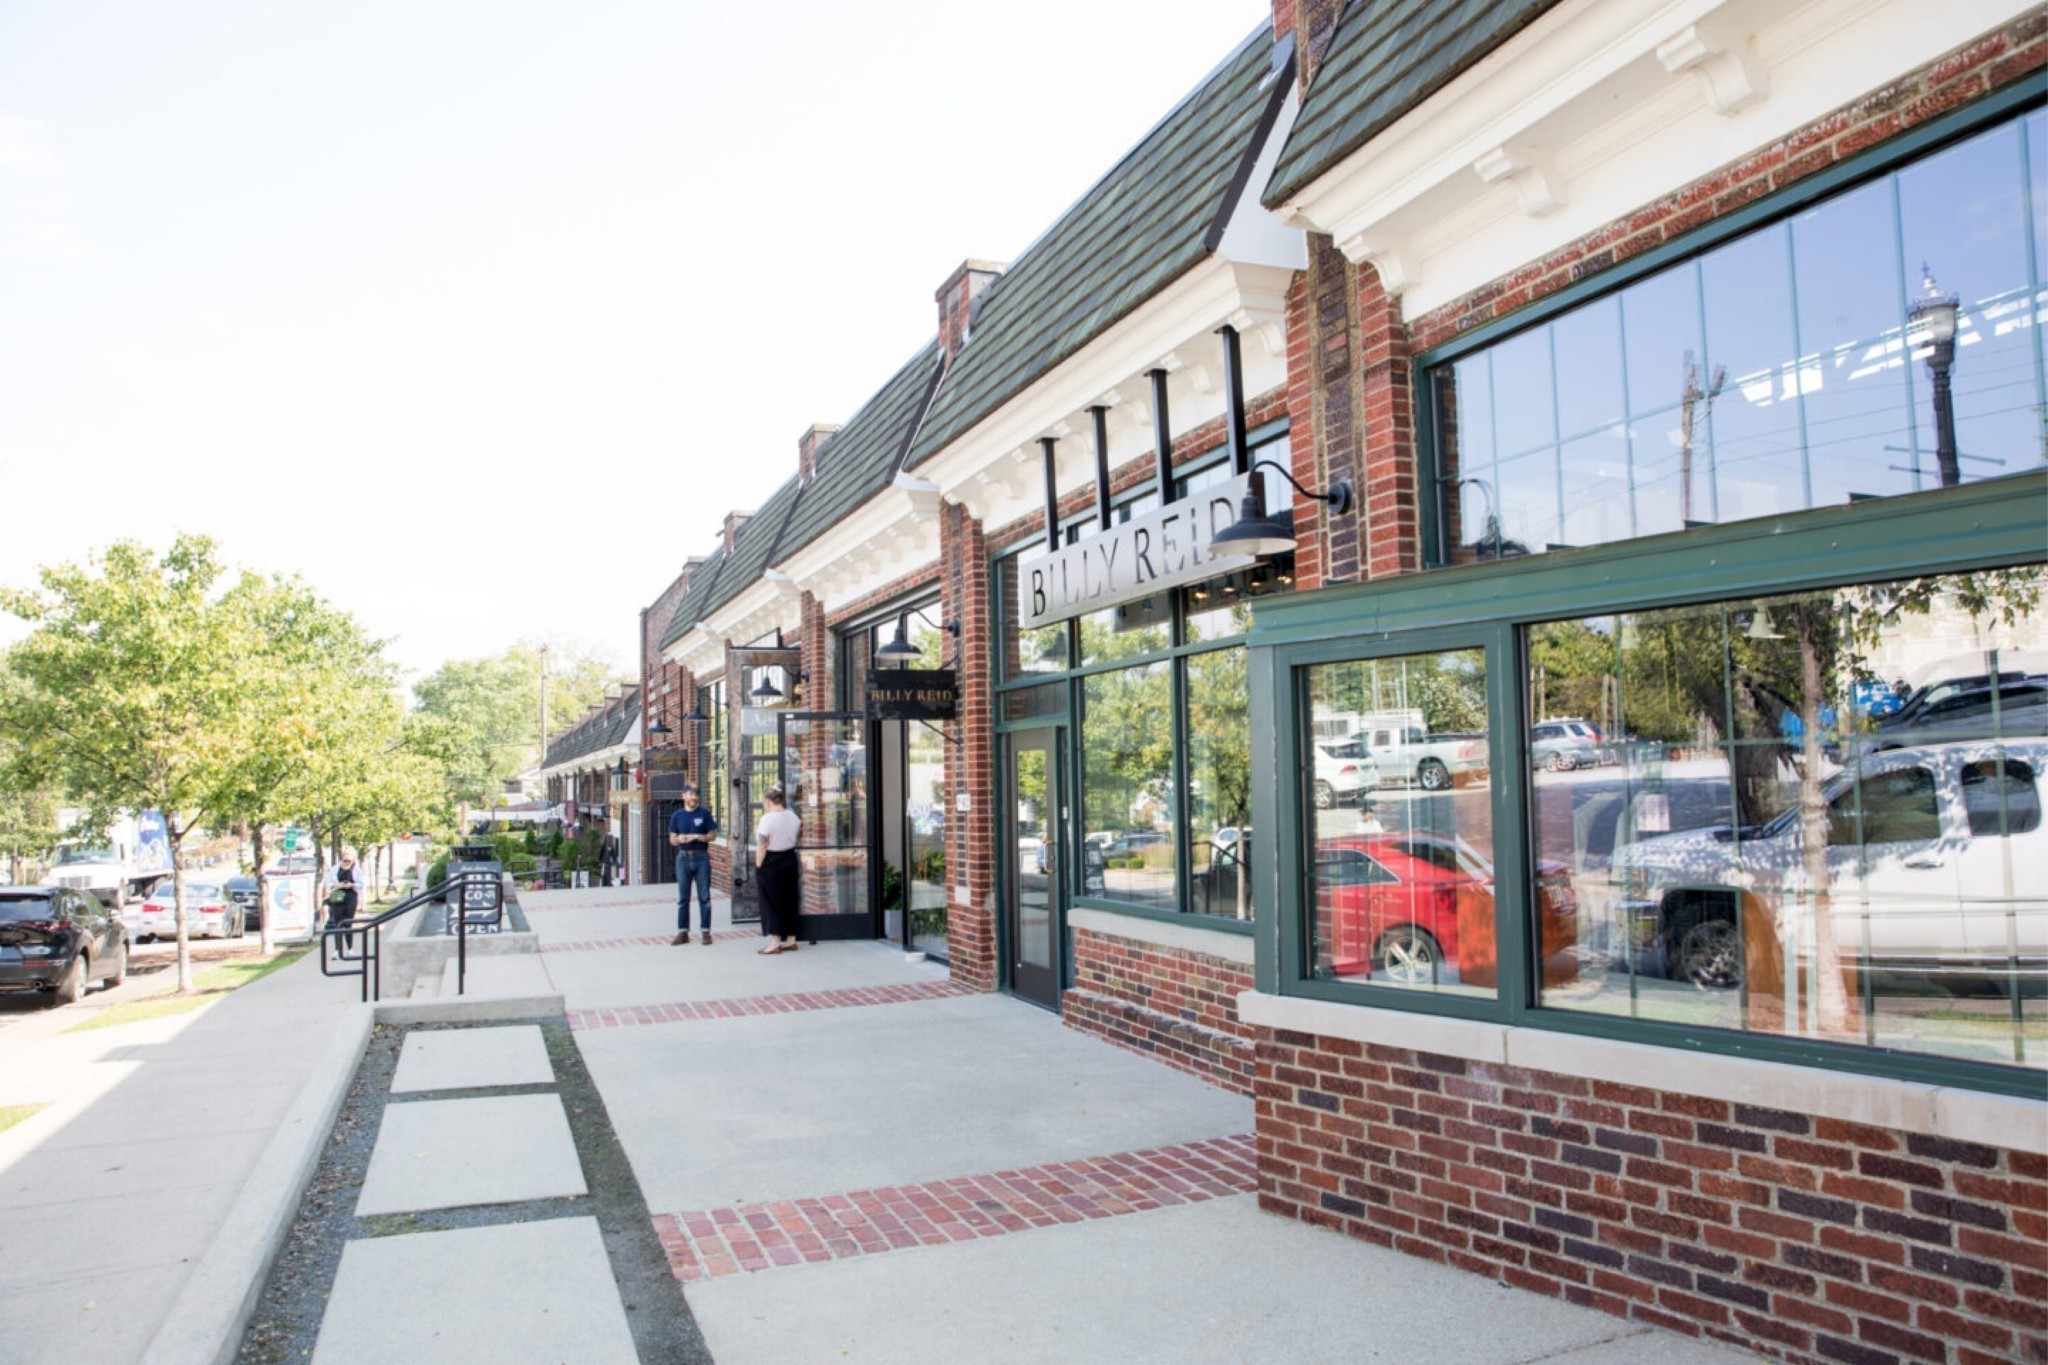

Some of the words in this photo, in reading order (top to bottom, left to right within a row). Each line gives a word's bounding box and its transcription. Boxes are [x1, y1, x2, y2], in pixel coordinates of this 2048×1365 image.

[1031, 537, 1119, 618] BILLY
[1134, 497, 1236, 584] REID
[871, 688, 913, 702] BILLY
[916, 689, 952, 702] REID
